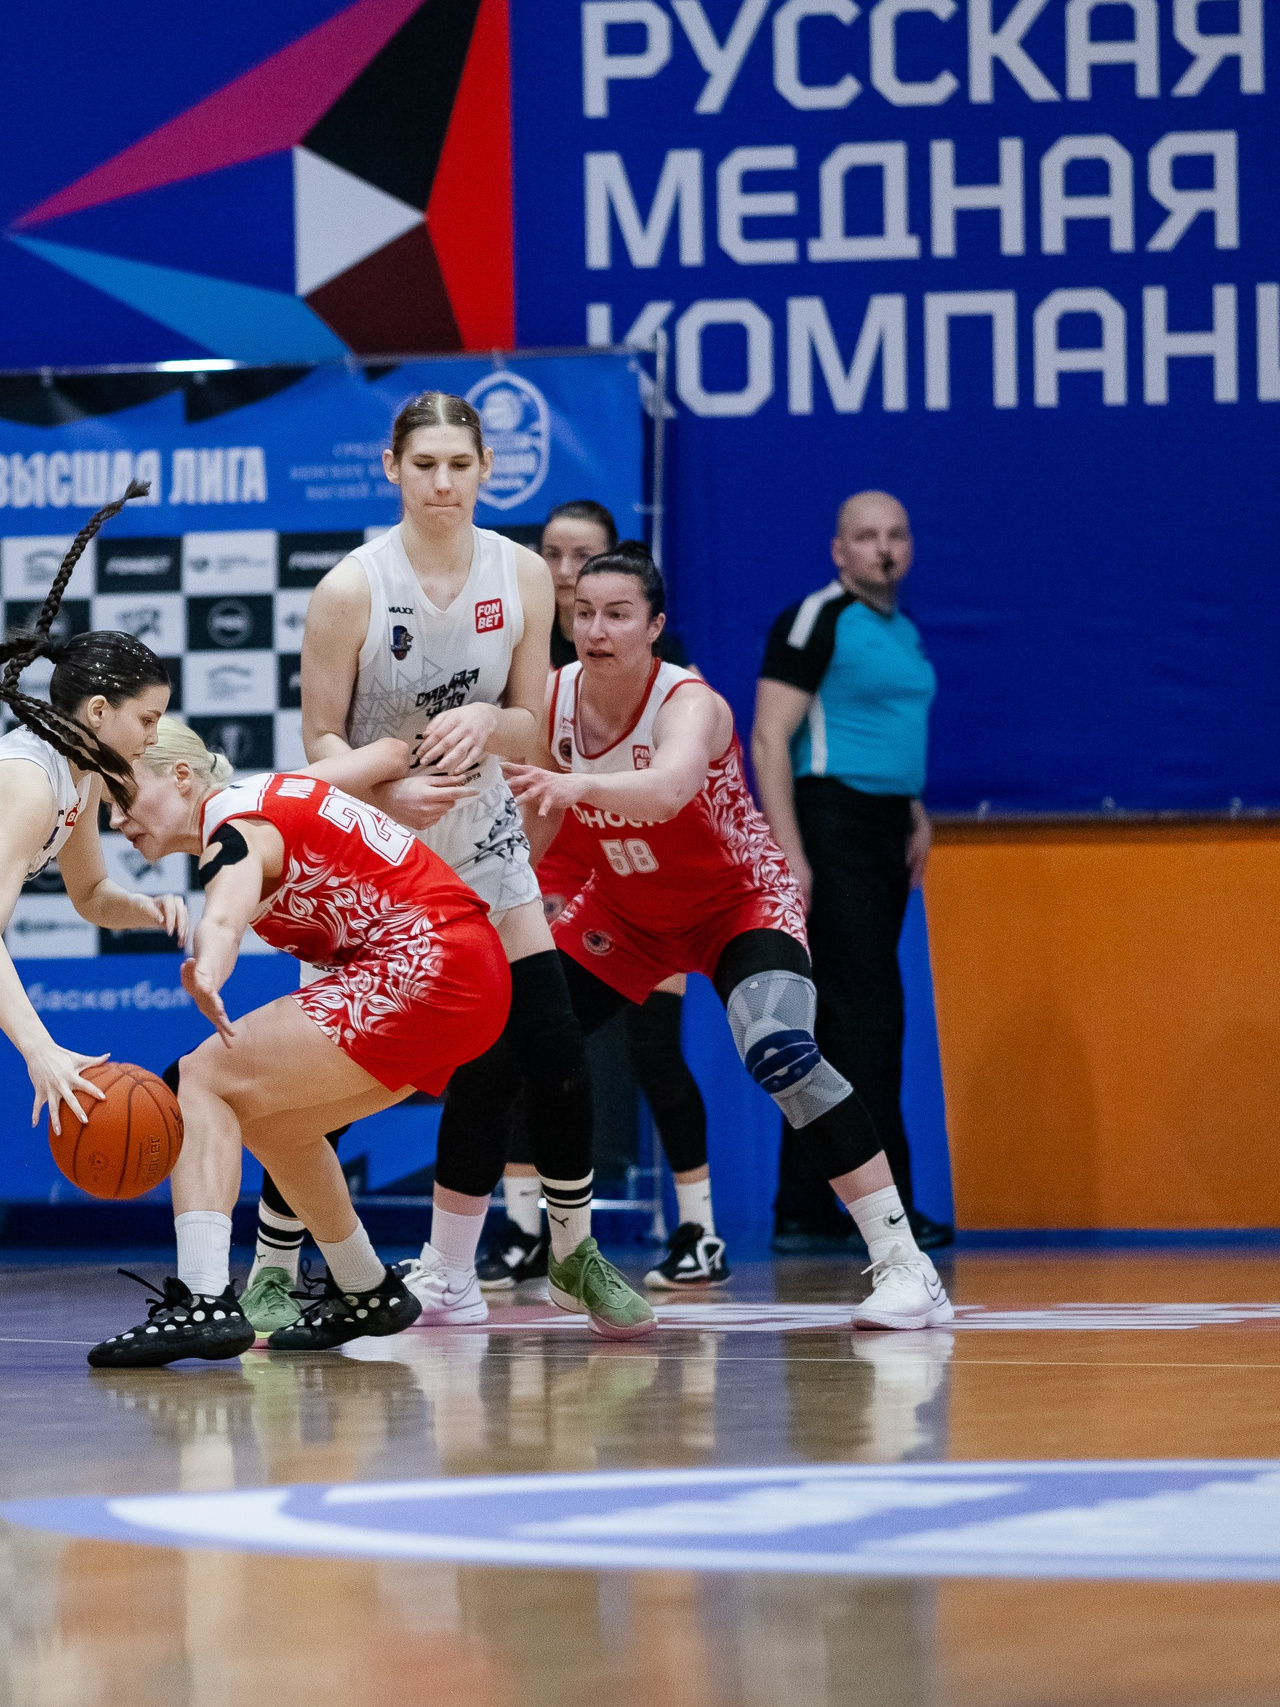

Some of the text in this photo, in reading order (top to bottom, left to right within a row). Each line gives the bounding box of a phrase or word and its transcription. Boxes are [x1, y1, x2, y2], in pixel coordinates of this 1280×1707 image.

[582, 0, 1265, 117] РУССКАЯ
[583, 130, 1239, 269] МЕДНАЯ
[169, 447, 268, 505] ЛИГА
[476, 601, 500, 617] FON
[477, 614, 502, 630] BET
[598, 838, 660, 877] 58
